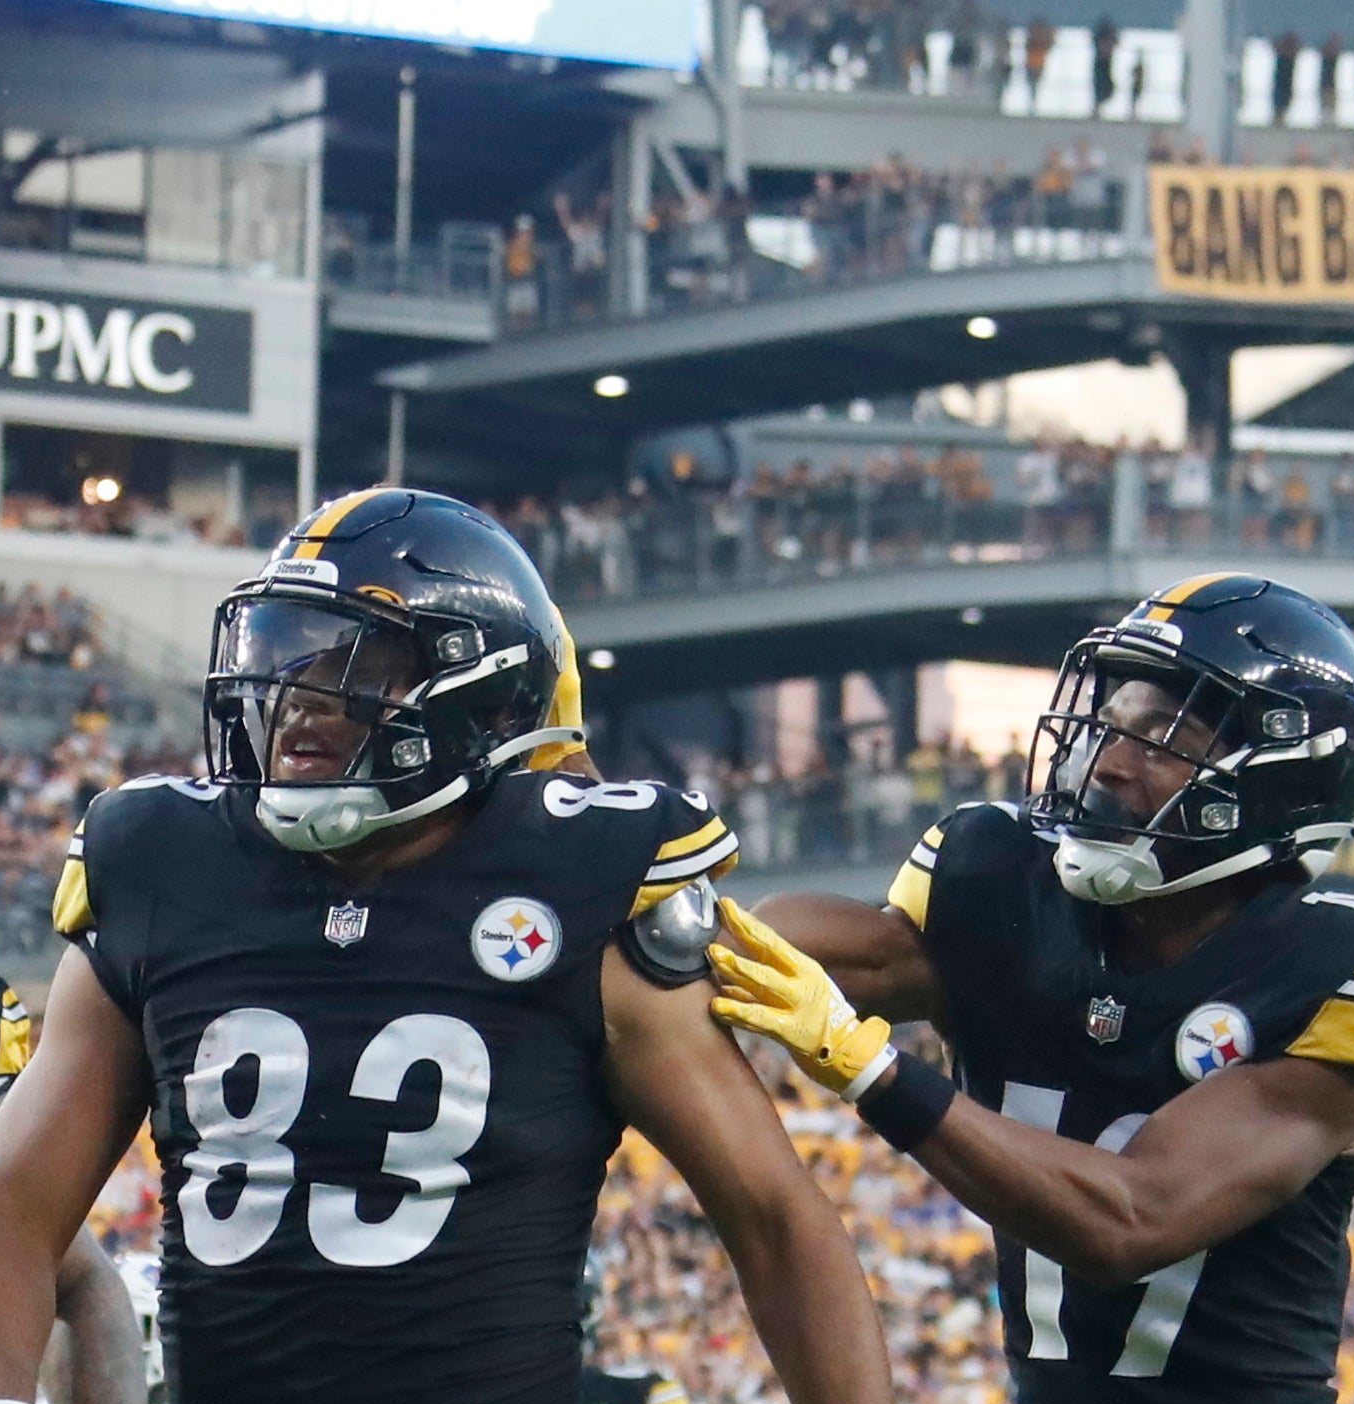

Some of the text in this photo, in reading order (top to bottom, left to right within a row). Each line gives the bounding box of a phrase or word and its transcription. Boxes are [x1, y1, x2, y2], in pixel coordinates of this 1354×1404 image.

[1166, 185, 1302, 286] BANG
[275, 561, 317, 576] Steelers
[480, 928, 514, 943] Steelers
[178, 1007, 490, 1267] 83
